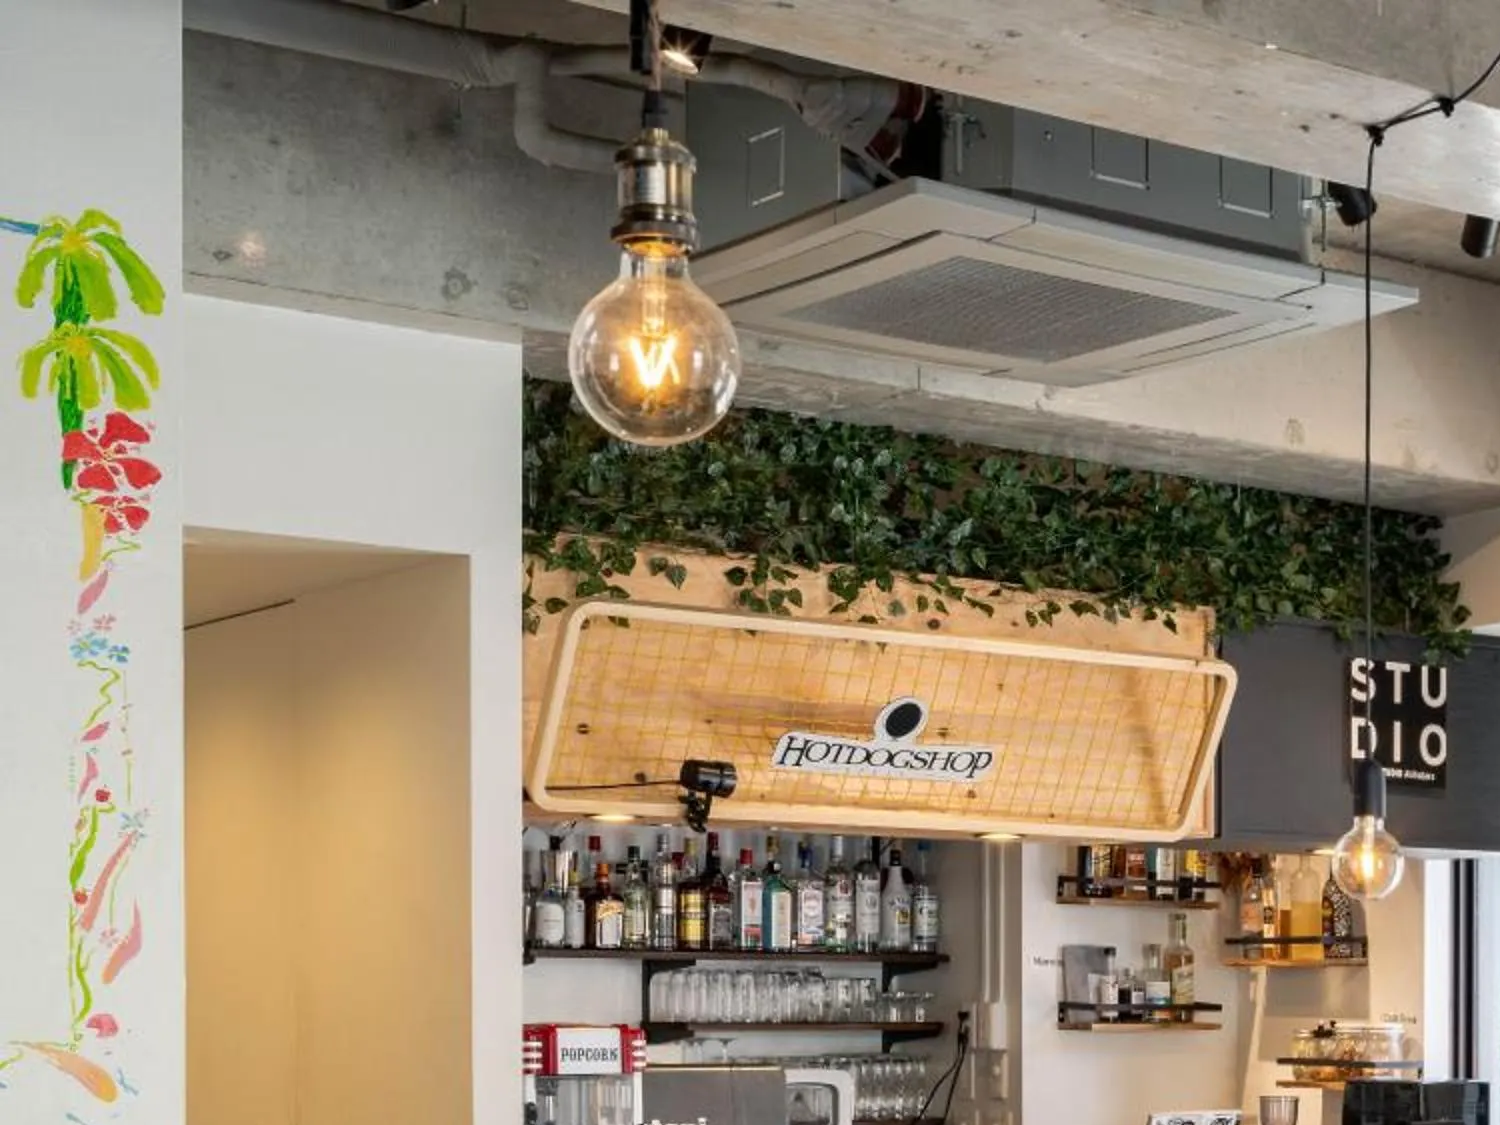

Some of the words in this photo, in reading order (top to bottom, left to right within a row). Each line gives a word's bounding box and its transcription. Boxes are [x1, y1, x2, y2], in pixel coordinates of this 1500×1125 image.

[1351, 657, 1447, 708] STU
[777, 735, 993, 779] HOTDOGSHOP
[1351, 716, 1447, 767] DIO
[560, 1047, 618, 1062] POPCORN
